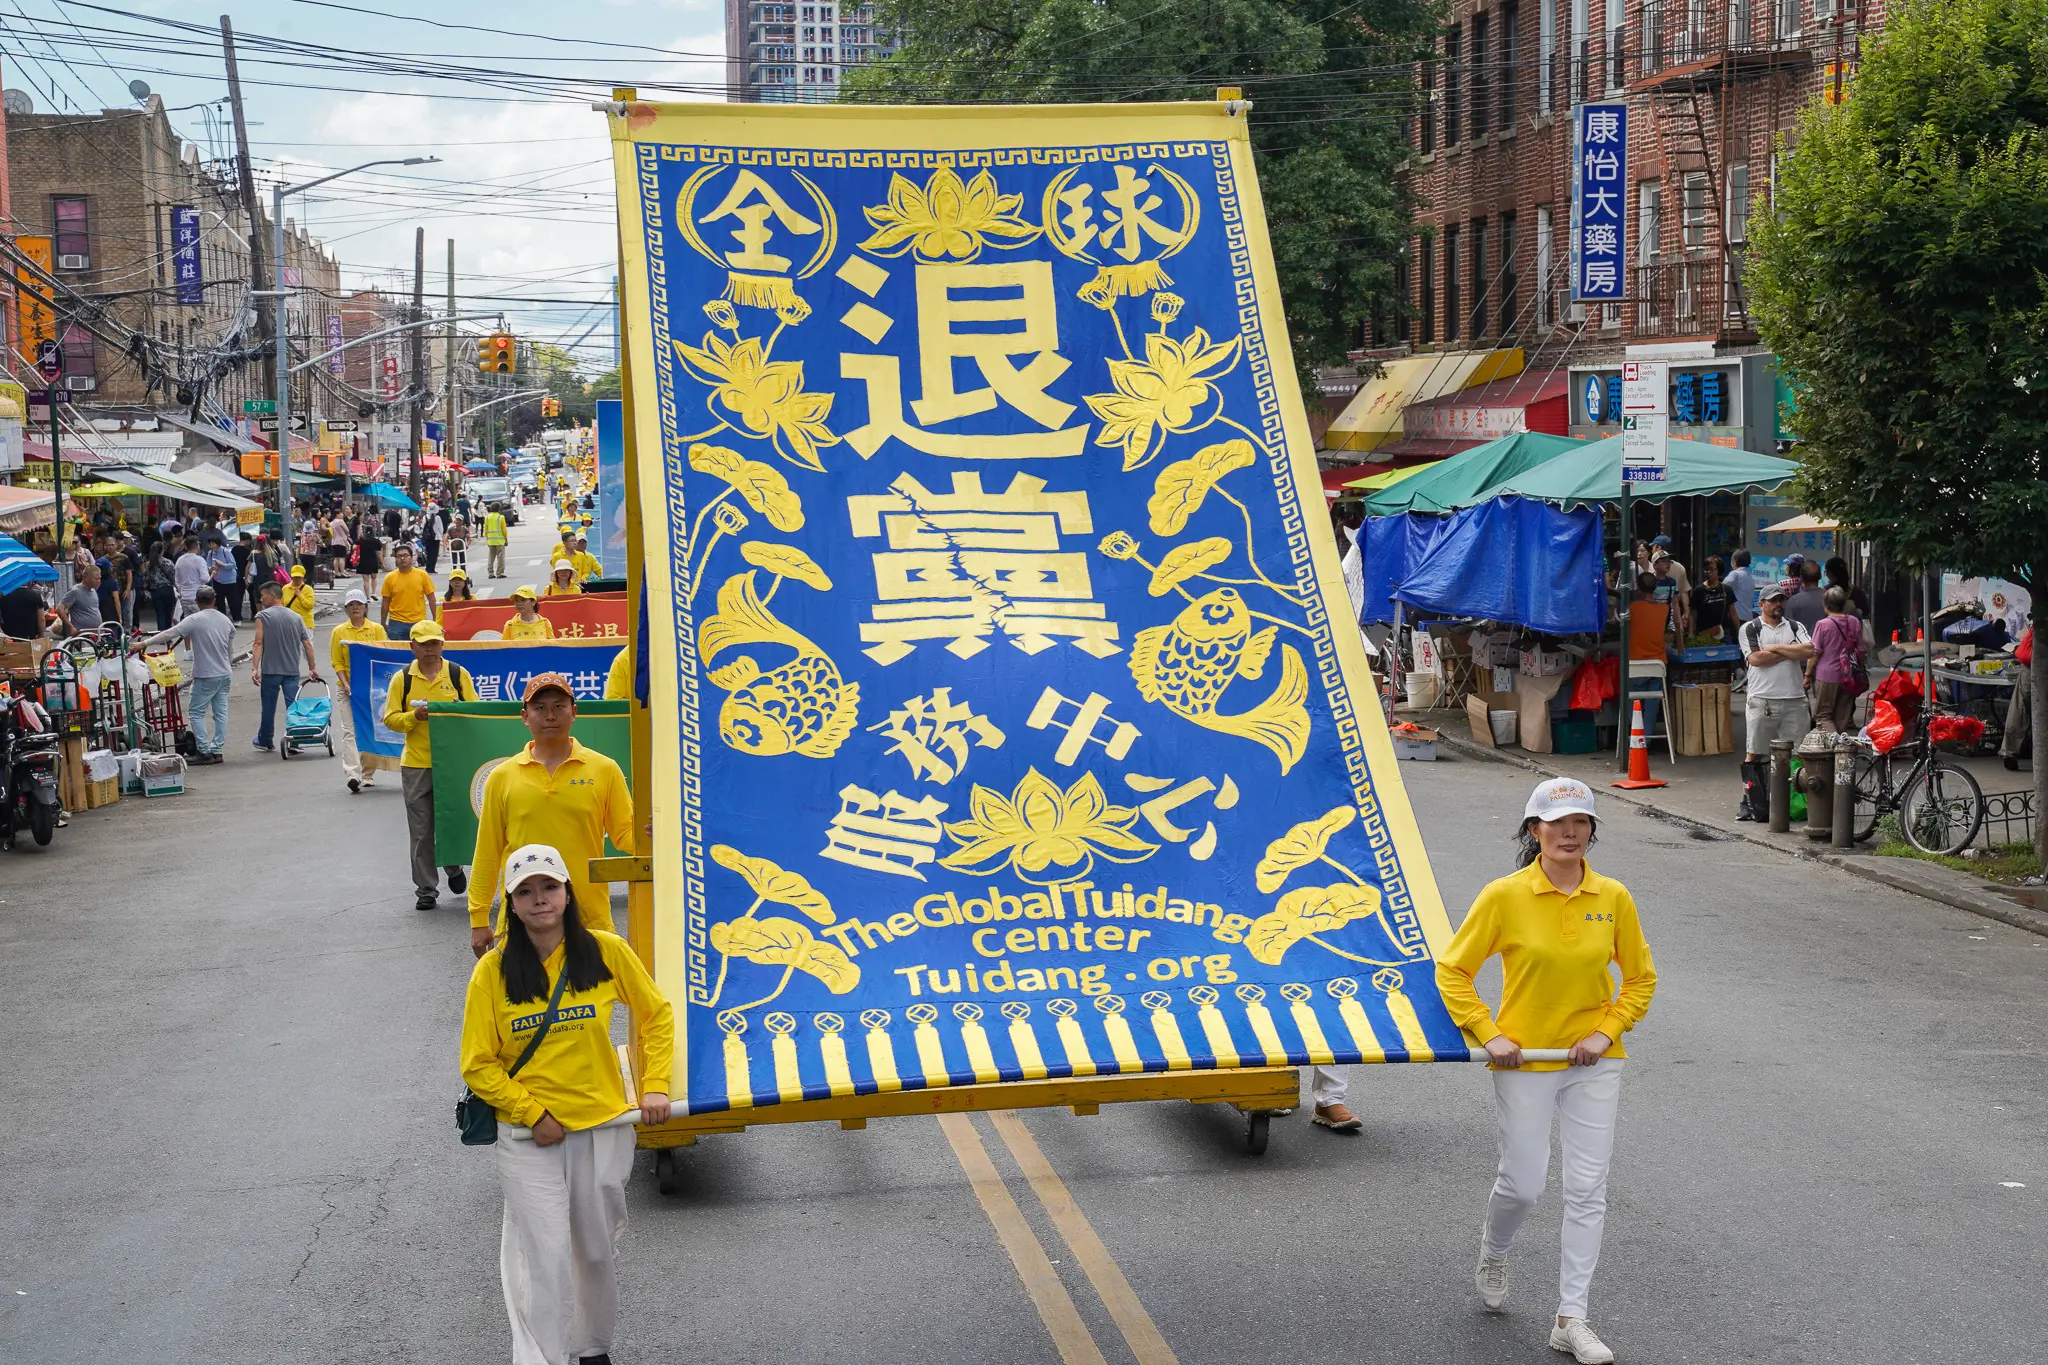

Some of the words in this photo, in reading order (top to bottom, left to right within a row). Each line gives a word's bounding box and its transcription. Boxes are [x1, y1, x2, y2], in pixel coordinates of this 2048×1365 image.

[1584, 110, 1620, 293] 康怡大藥房
[699, 169, 822, 271] 全
[1059, 165, 1189, 261] 球
[56, 391, 68, 401] B70
[252, 402, 261, 411] 57
[264, 420, 278, 429] ONE
[1626, 416, 1634, 429] 2
[972, 920, 1152, 958] Center
[558, 1006, 593, 1021] DAFA
